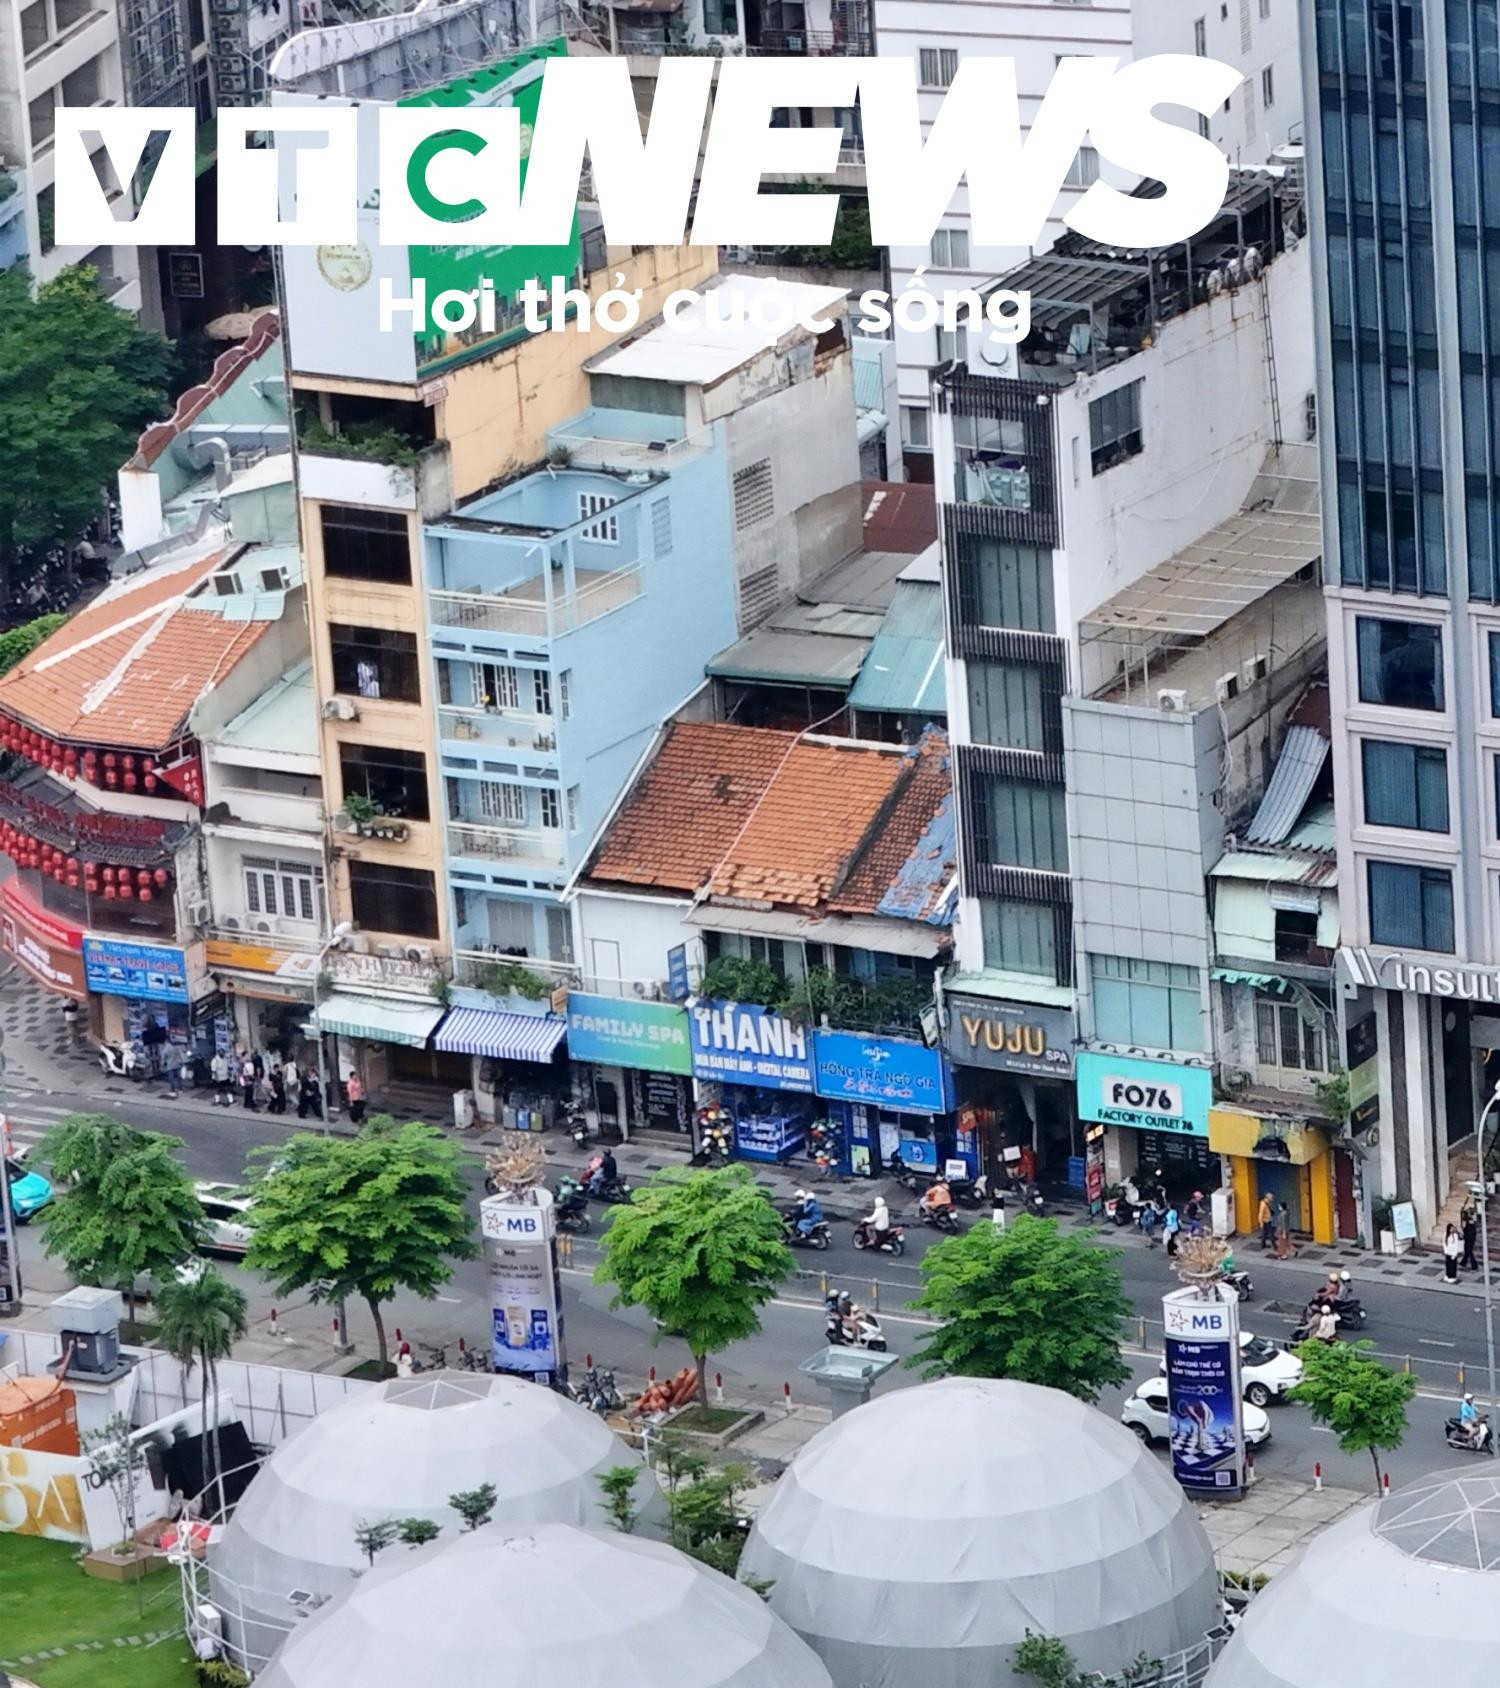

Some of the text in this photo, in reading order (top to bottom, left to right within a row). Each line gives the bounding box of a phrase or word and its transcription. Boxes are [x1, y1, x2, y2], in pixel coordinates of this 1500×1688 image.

[572, 1014, 685, 1045] FAMILY SPA
[962, 1015, 1044, 1056] YUJU
[1046, 1050, 1068, 1062] SPA
[1112, 1083, 1172, 1110] FO76
[1098, 1108, 1194, 1131] FACTORY OUTLET 76
[507, 1218, 537, 1232] MB
[1192, 1315, 1223, 1330] MB
